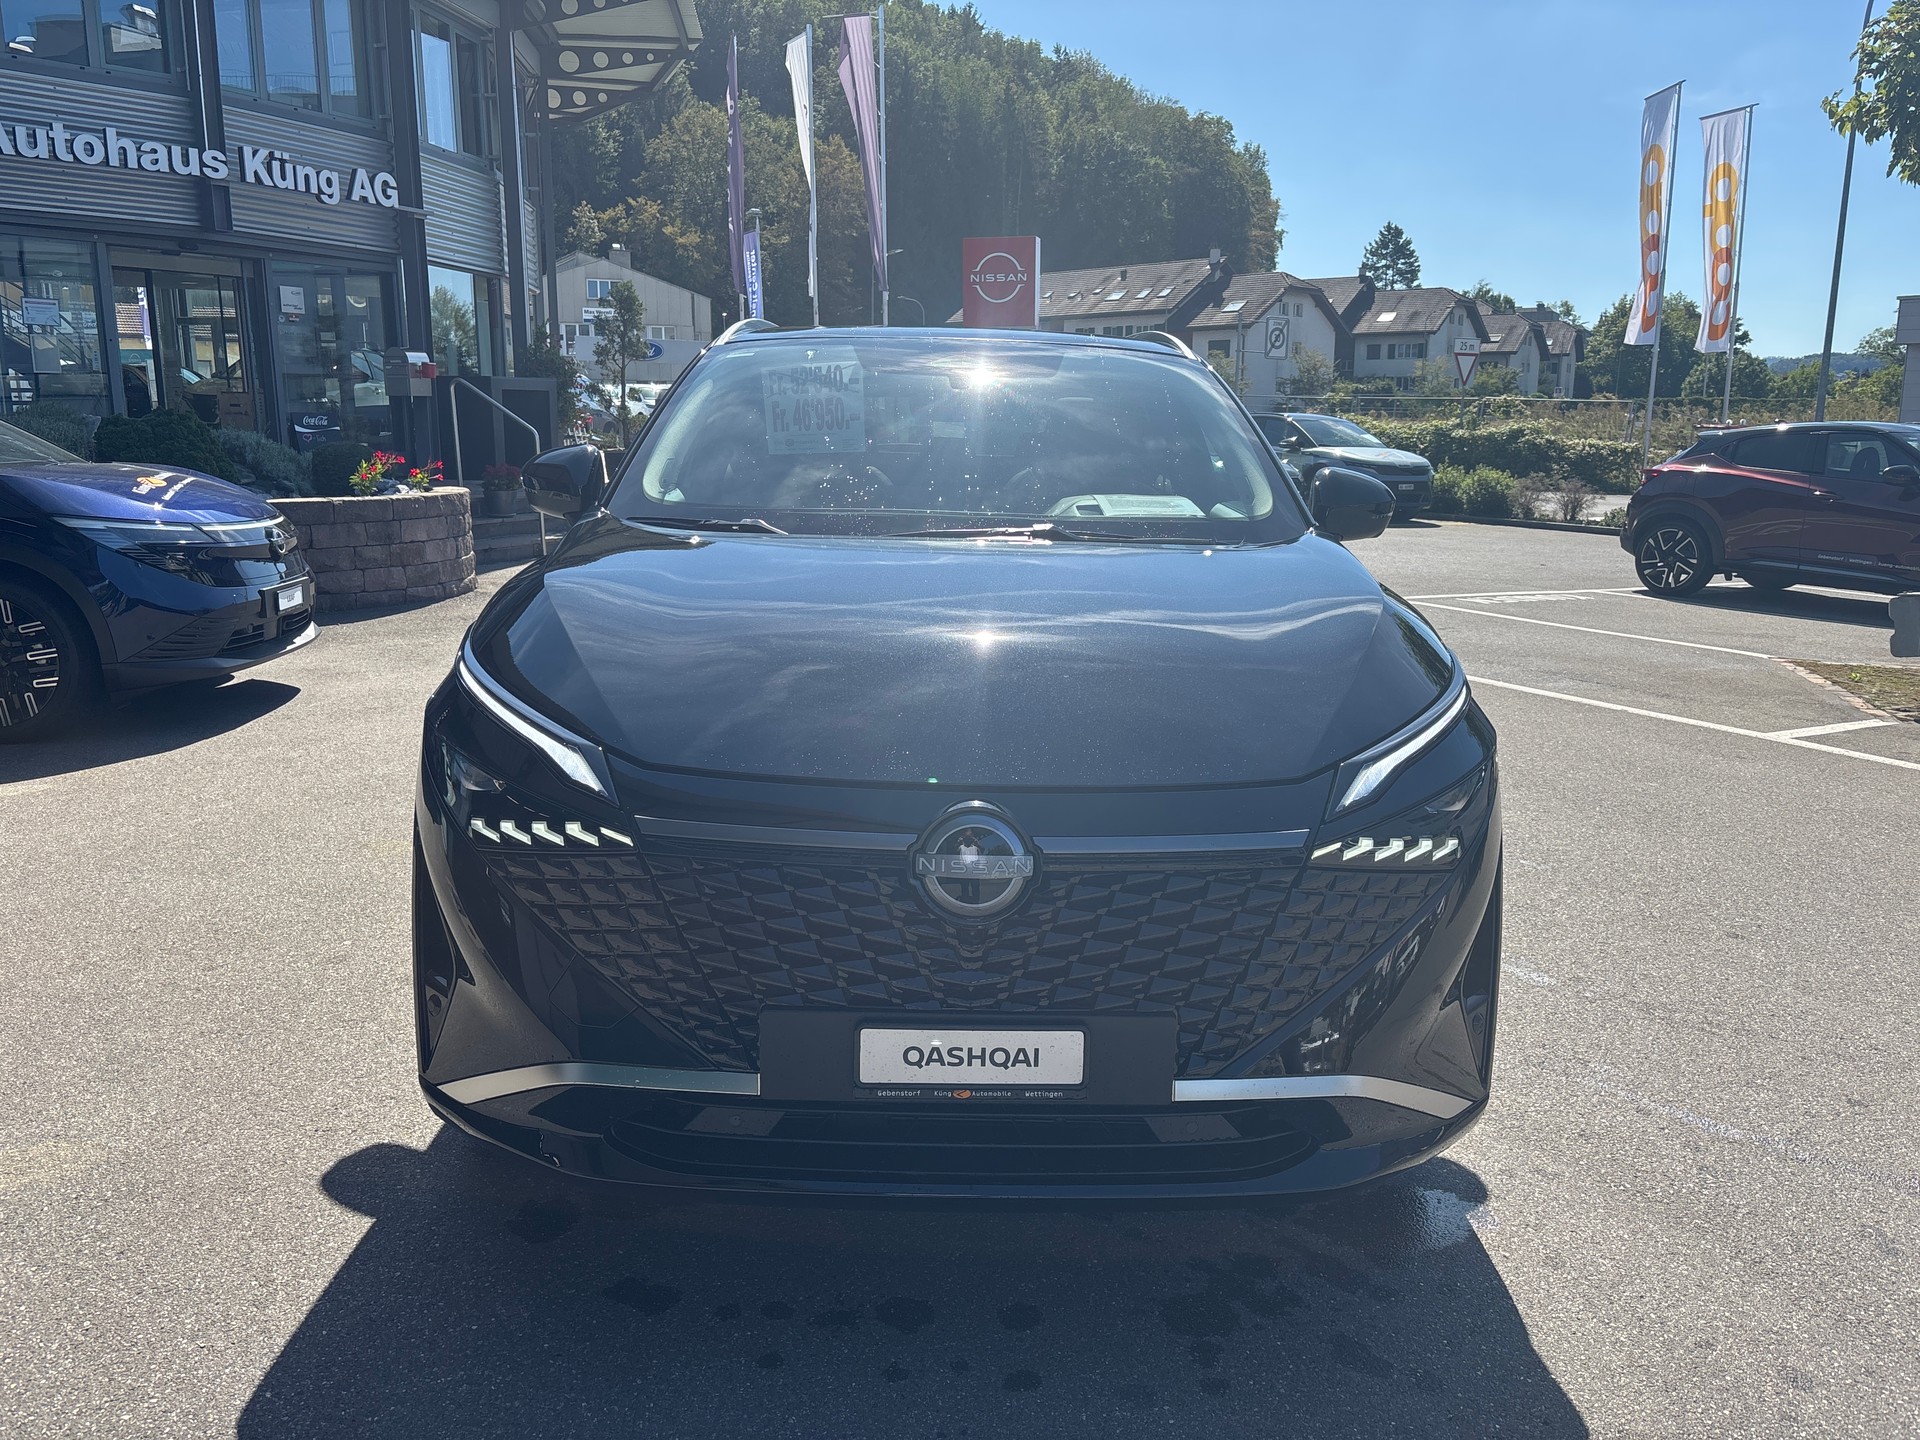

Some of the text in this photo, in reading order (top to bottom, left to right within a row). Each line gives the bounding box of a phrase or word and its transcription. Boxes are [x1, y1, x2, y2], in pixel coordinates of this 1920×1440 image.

[240, 145, 340, 205] Küng
[350, 168, 399, 208] AG
[970, 273, 1027, 282] NISSAN
[1460, 341, 1468, 351] 25
[771, 400, 790, 433] Fr.
[919, 857, 1031, 875] NISSAN
[902, 1045, 1040, 1070] QASHQAI
[877, 1089, 921, 1097] Gebenstorf
[934, 1089, 952, 1099] Küng
[1025, 1090, 1064, 1098] Wettingen
